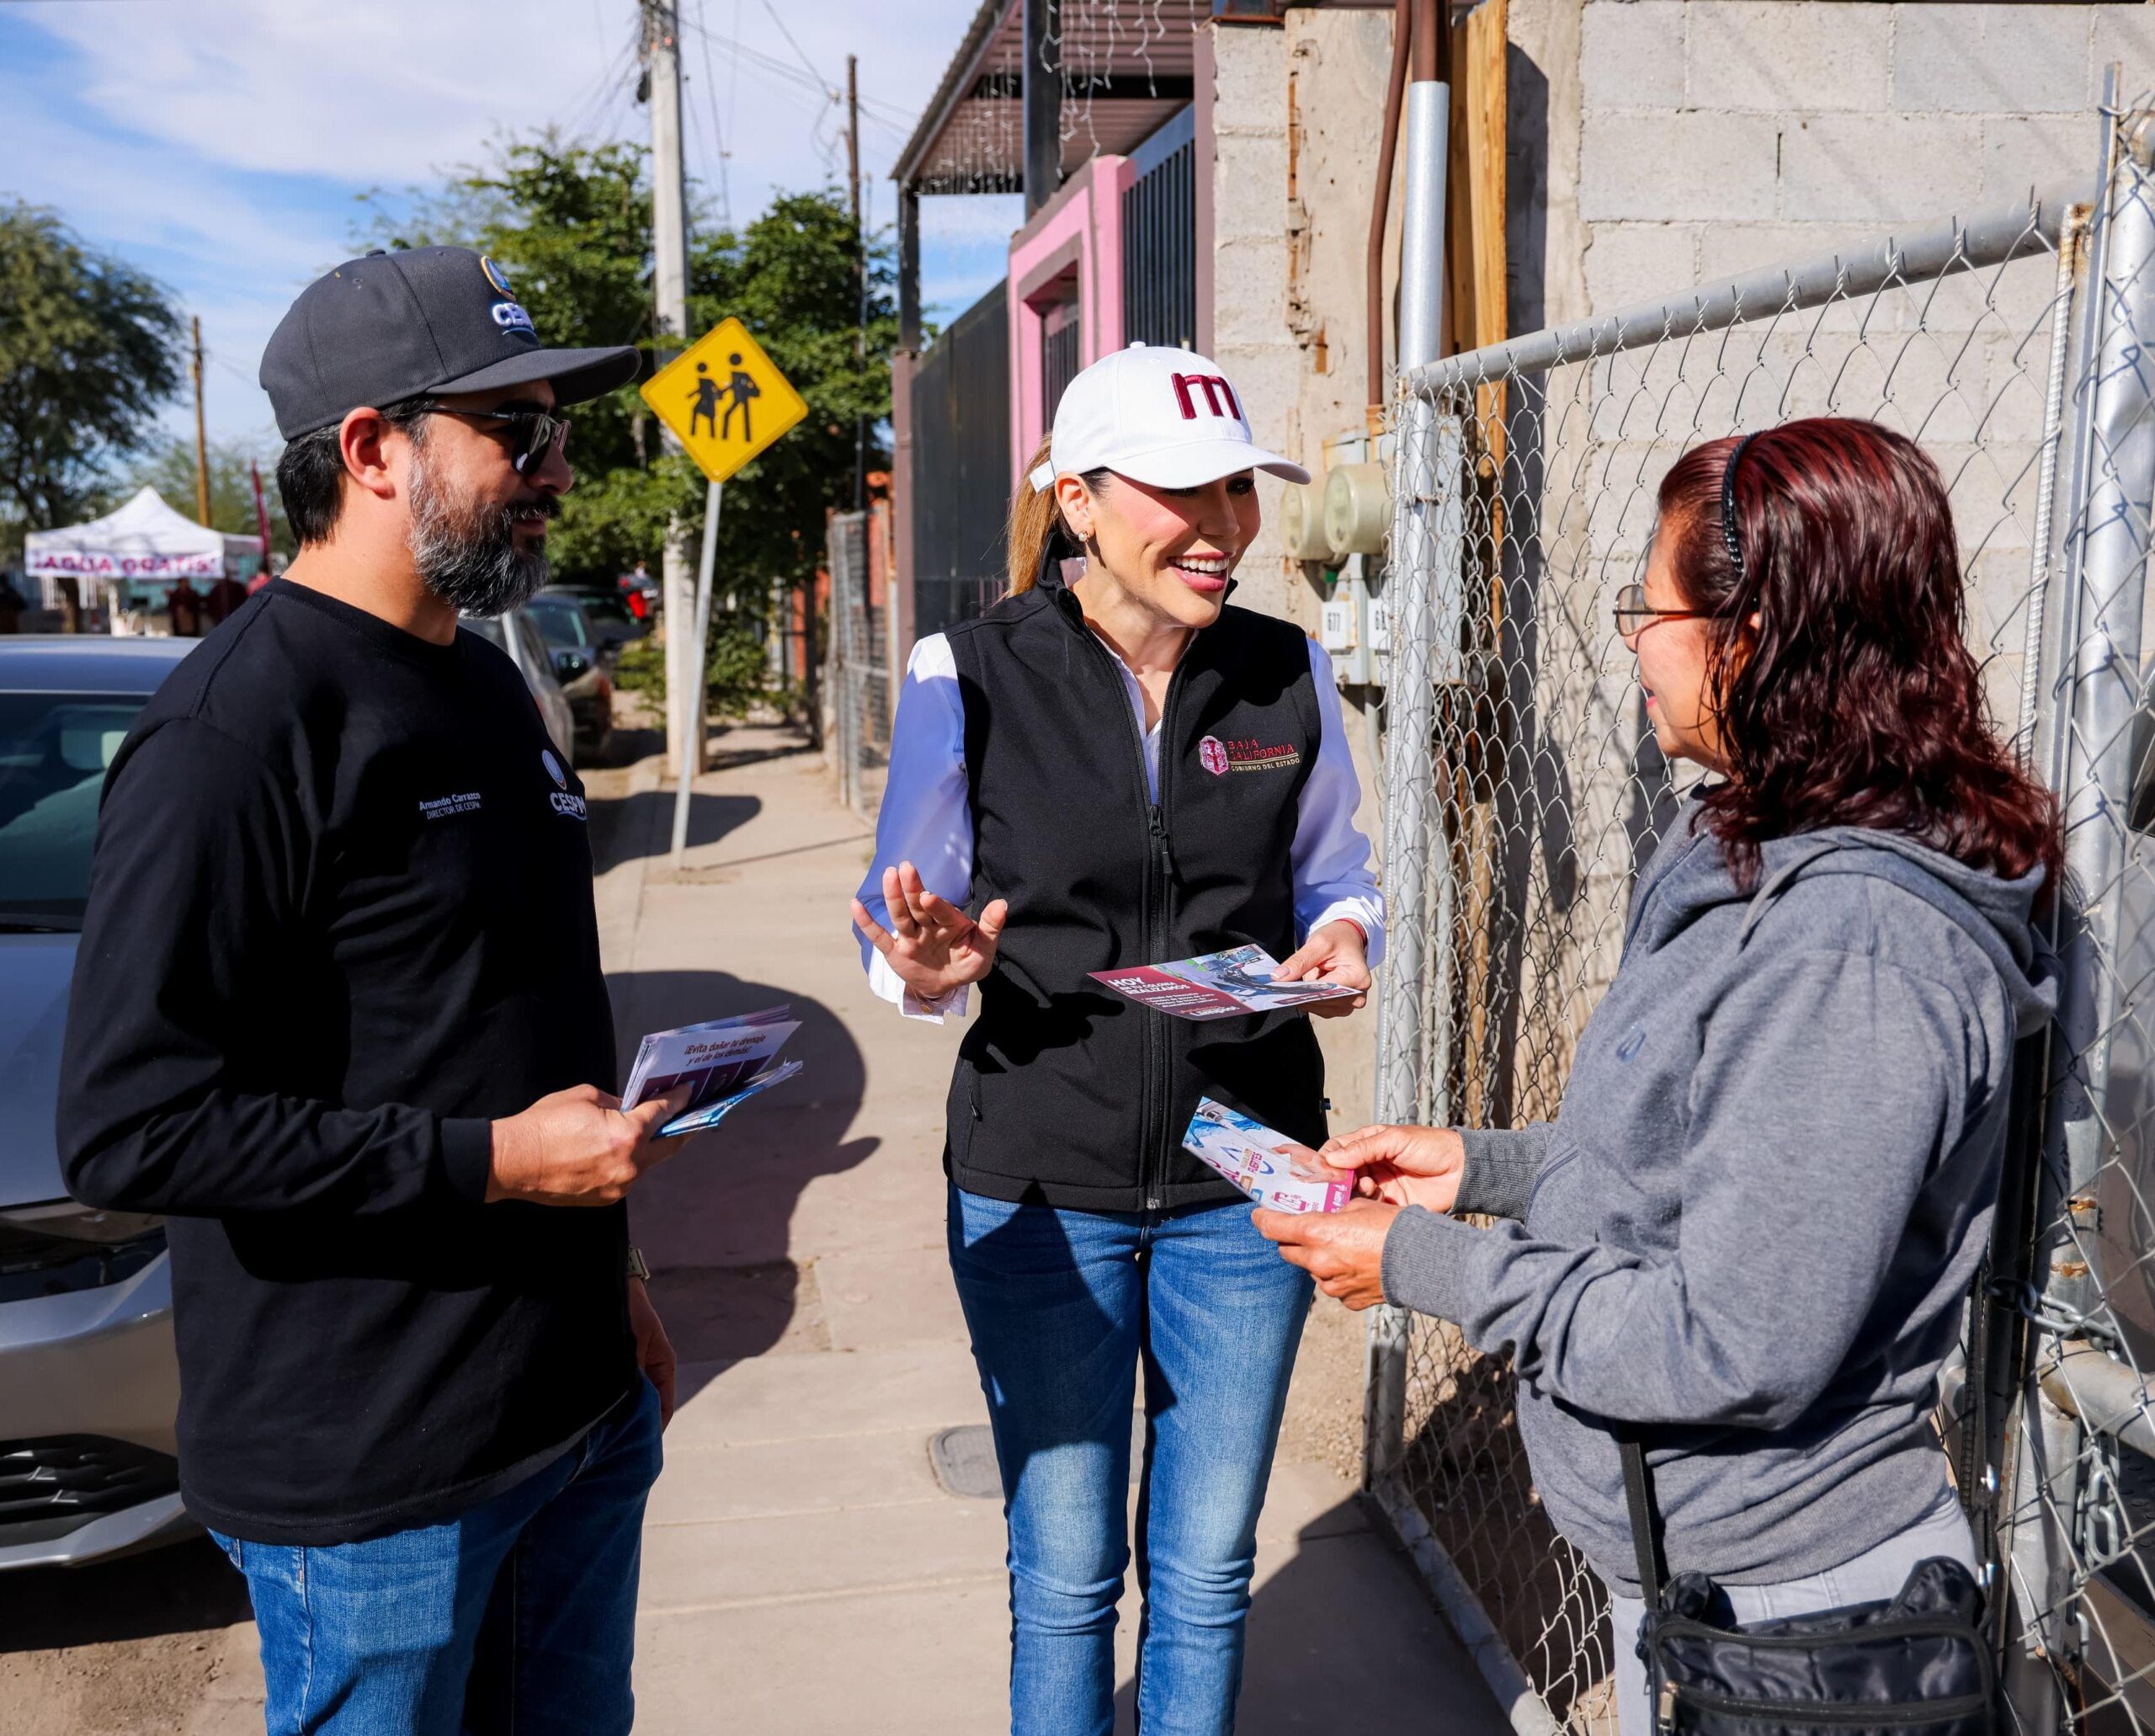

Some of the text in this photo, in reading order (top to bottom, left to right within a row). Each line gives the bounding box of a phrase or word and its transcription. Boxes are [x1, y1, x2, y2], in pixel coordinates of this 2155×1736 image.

[1227, 739, 1258, 749] BAJA
[1229, 743, 1295, 760] CALIFORNIA
[1275, 758, 1300, 768] ESTADO
[419, 796, 452, 811] Armando
[426, 806, 455, 820] DIRECTOR
[455, 803, 464, 812] DE
[1107, 977, 1145, 987] HOY
[1125, 984, 1191, 994] REALIZAMOS
[684, 1043, 707, 1055] ¡Evita
[686, 1058, 694, 1067] y
